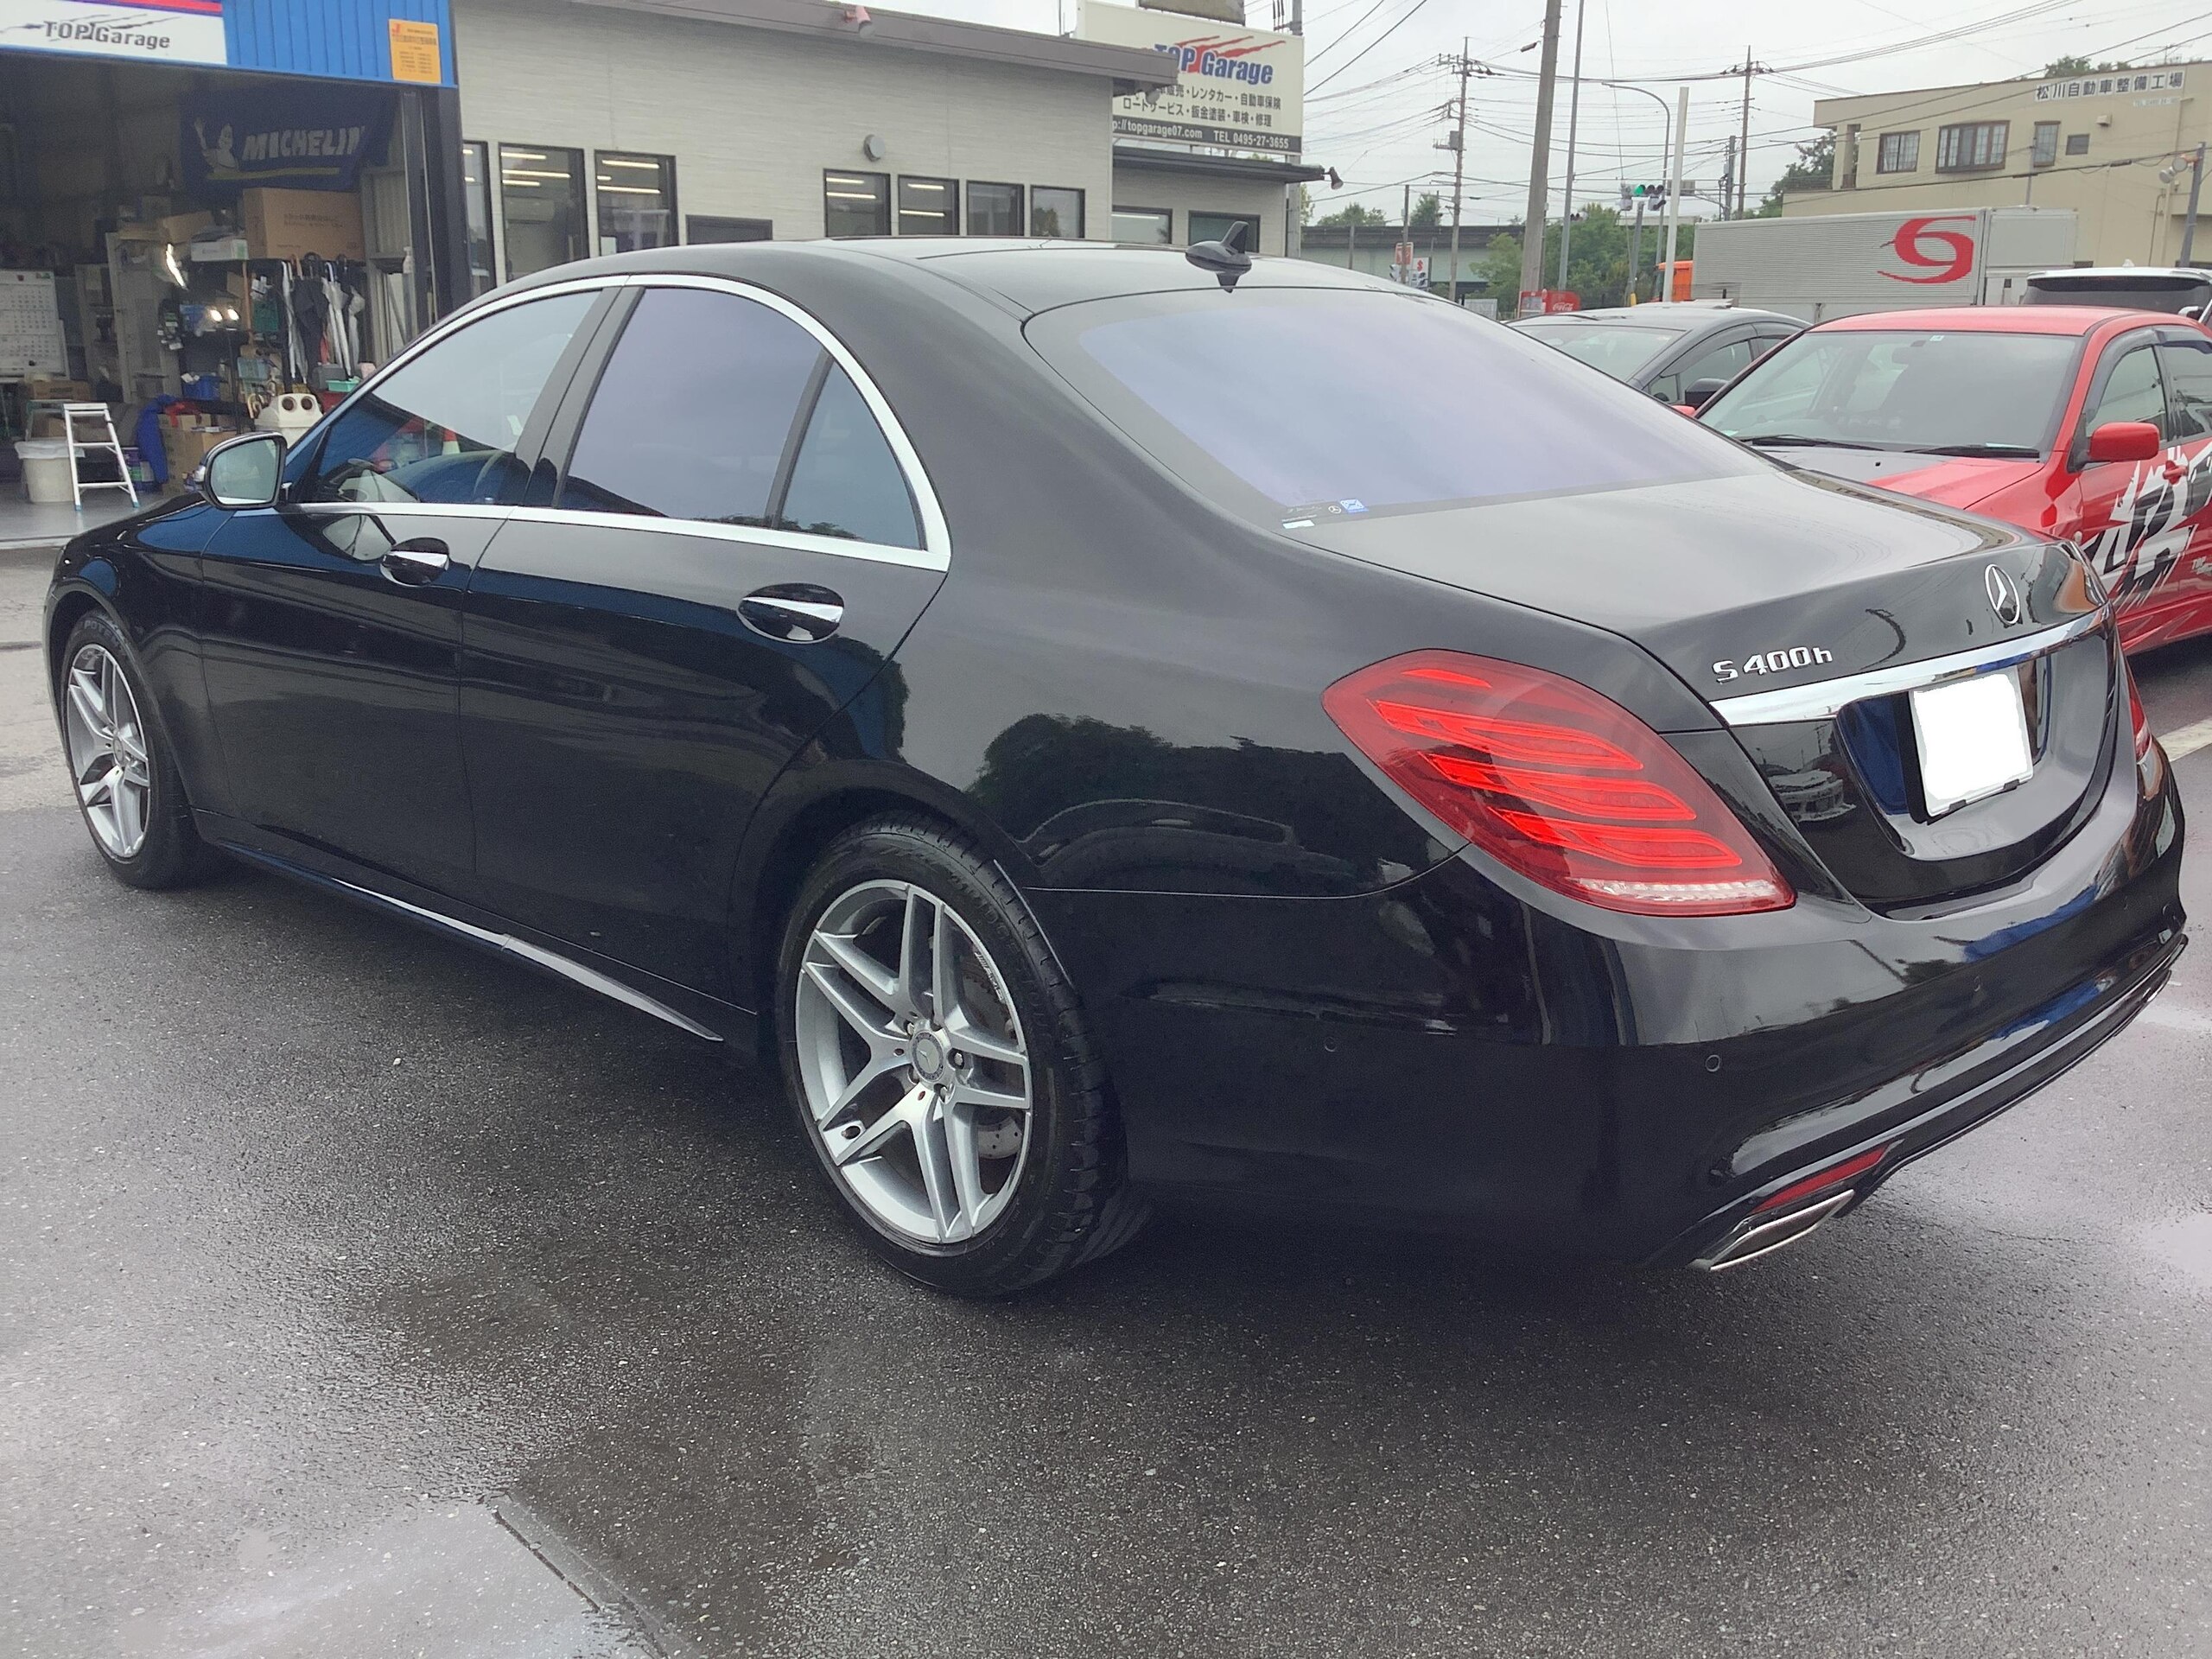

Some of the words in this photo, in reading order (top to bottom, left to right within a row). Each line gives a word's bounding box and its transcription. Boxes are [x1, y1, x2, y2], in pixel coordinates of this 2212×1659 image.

[43, 21, 90, 40] TOP
[94, 26, 170, 50] Garage
[1202, 51, 1273, 85] Garage
[2037, 73, 2183, 100] 松川自動車整備工場
[1213, 130, 1230, 143] TEL
[1233, 132, 1289, 149] 0495-27-3655
[1713, 660, 1739, 684] S
[1743, 646, 1833, 676] 400h
